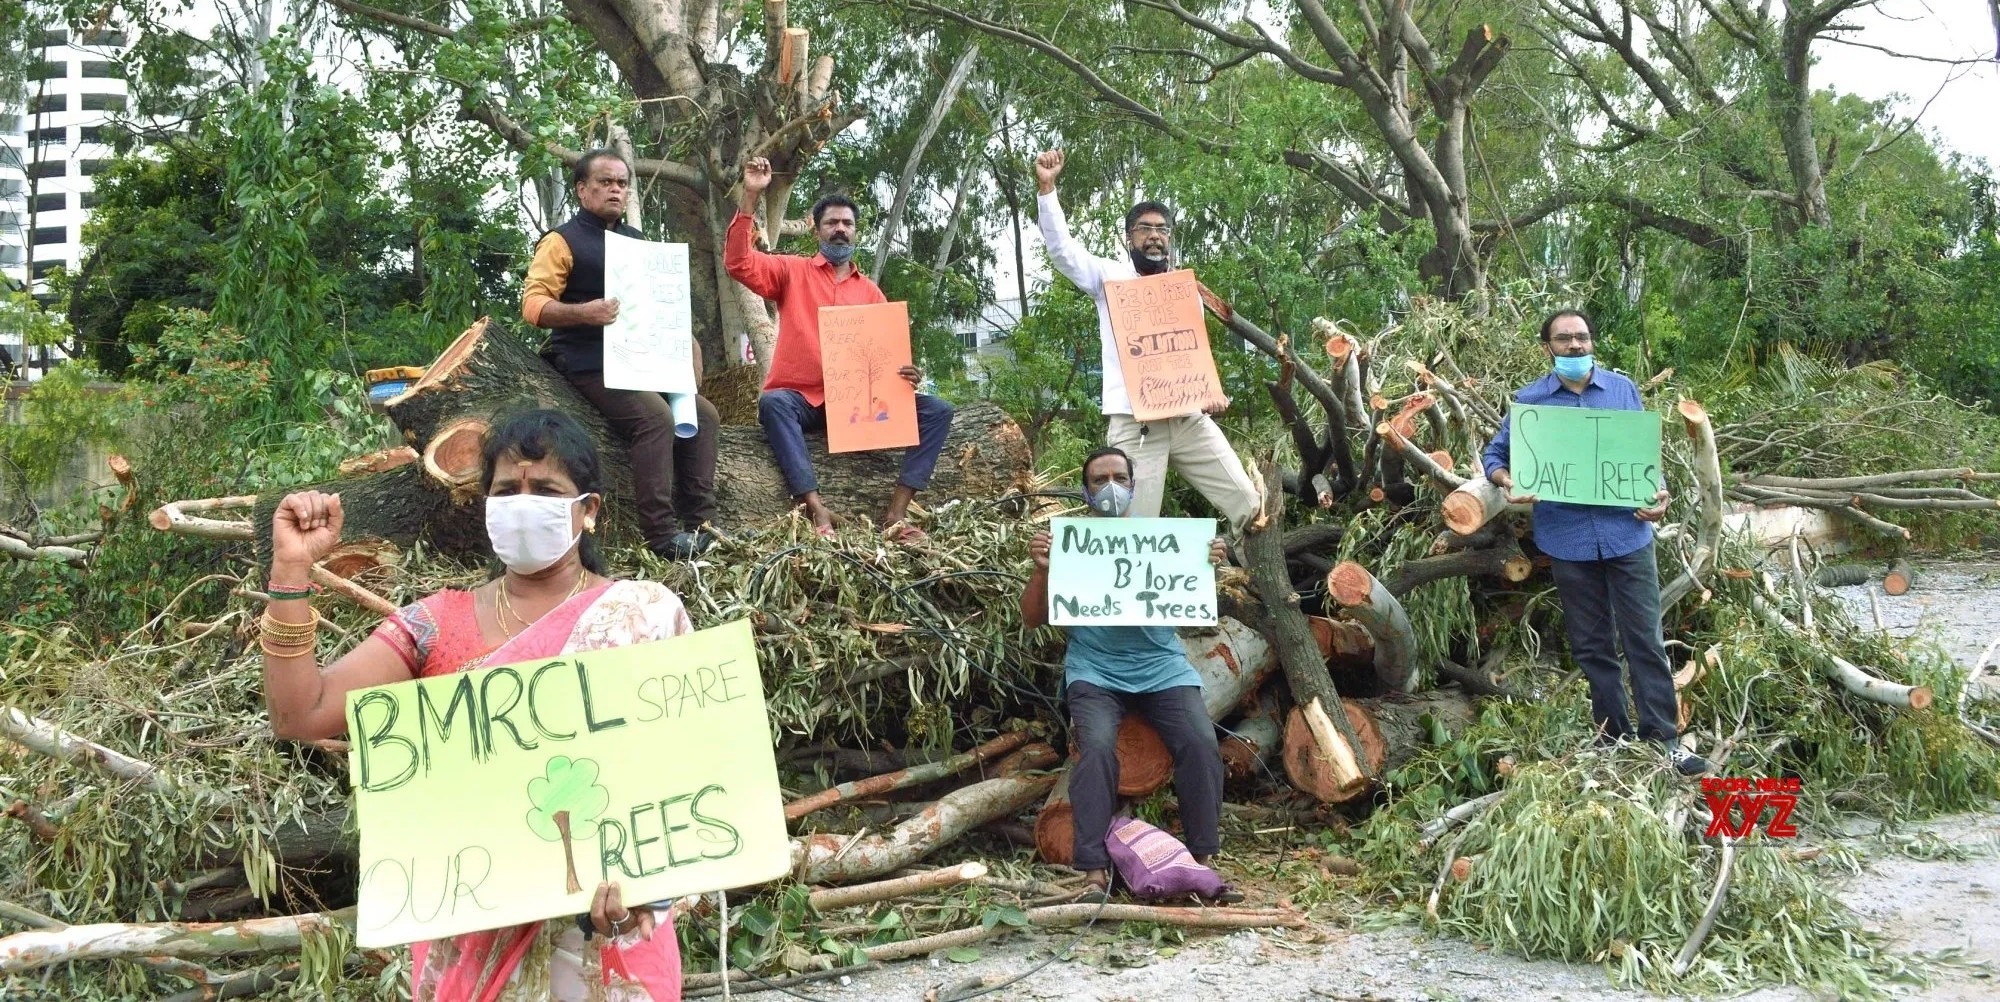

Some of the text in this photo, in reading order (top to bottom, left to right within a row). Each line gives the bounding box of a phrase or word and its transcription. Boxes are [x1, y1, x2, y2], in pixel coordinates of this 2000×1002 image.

[1112, 279, 1193, 309] BE A PART
[1122, 302, 1179, 331] OF THE
[1127, 329, 1198, 360] SOLUTION
[825, 367, 851, 382] OUR
[825, 386, 862, 404] DUTY
[1518, 409, 1659, 506] SAVE TREES
[1062, 525, 1181, 556] Namma
[1113, 557, 1198, 592] B'lore
[1053, 591, 1217, 622] Needs Trees.
[353, 659, 747, 793] BMRCL SPARE
[357, 845, 498, 931] OUR
